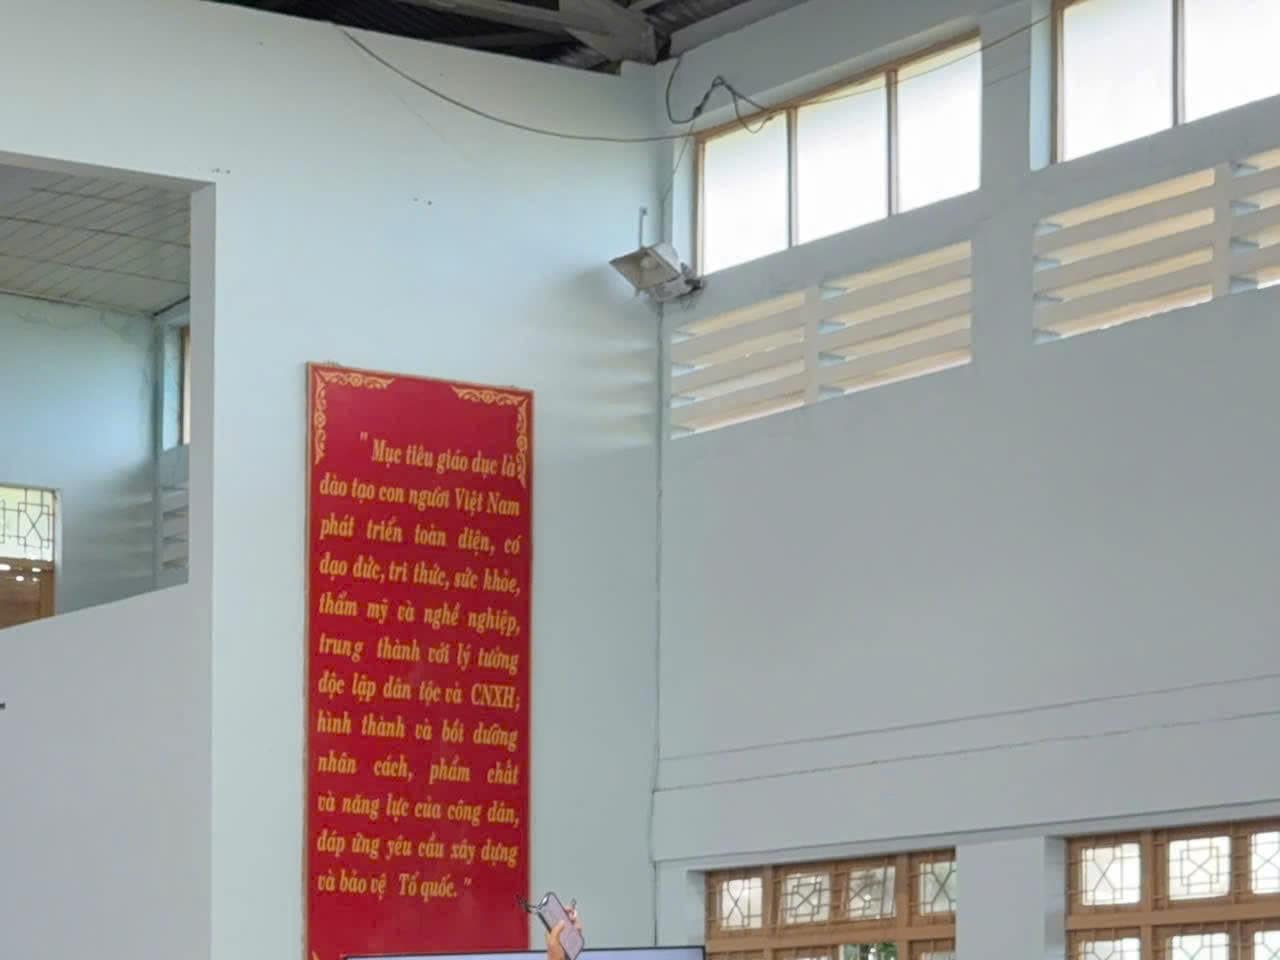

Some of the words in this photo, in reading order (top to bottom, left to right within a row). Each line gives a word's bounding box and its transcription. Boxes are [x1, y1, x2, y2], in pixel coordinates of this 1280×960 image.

[379, 485, 405, 504] con
[486, 490, 520, 517] Nam
[318, 631, 365, 663] trung
